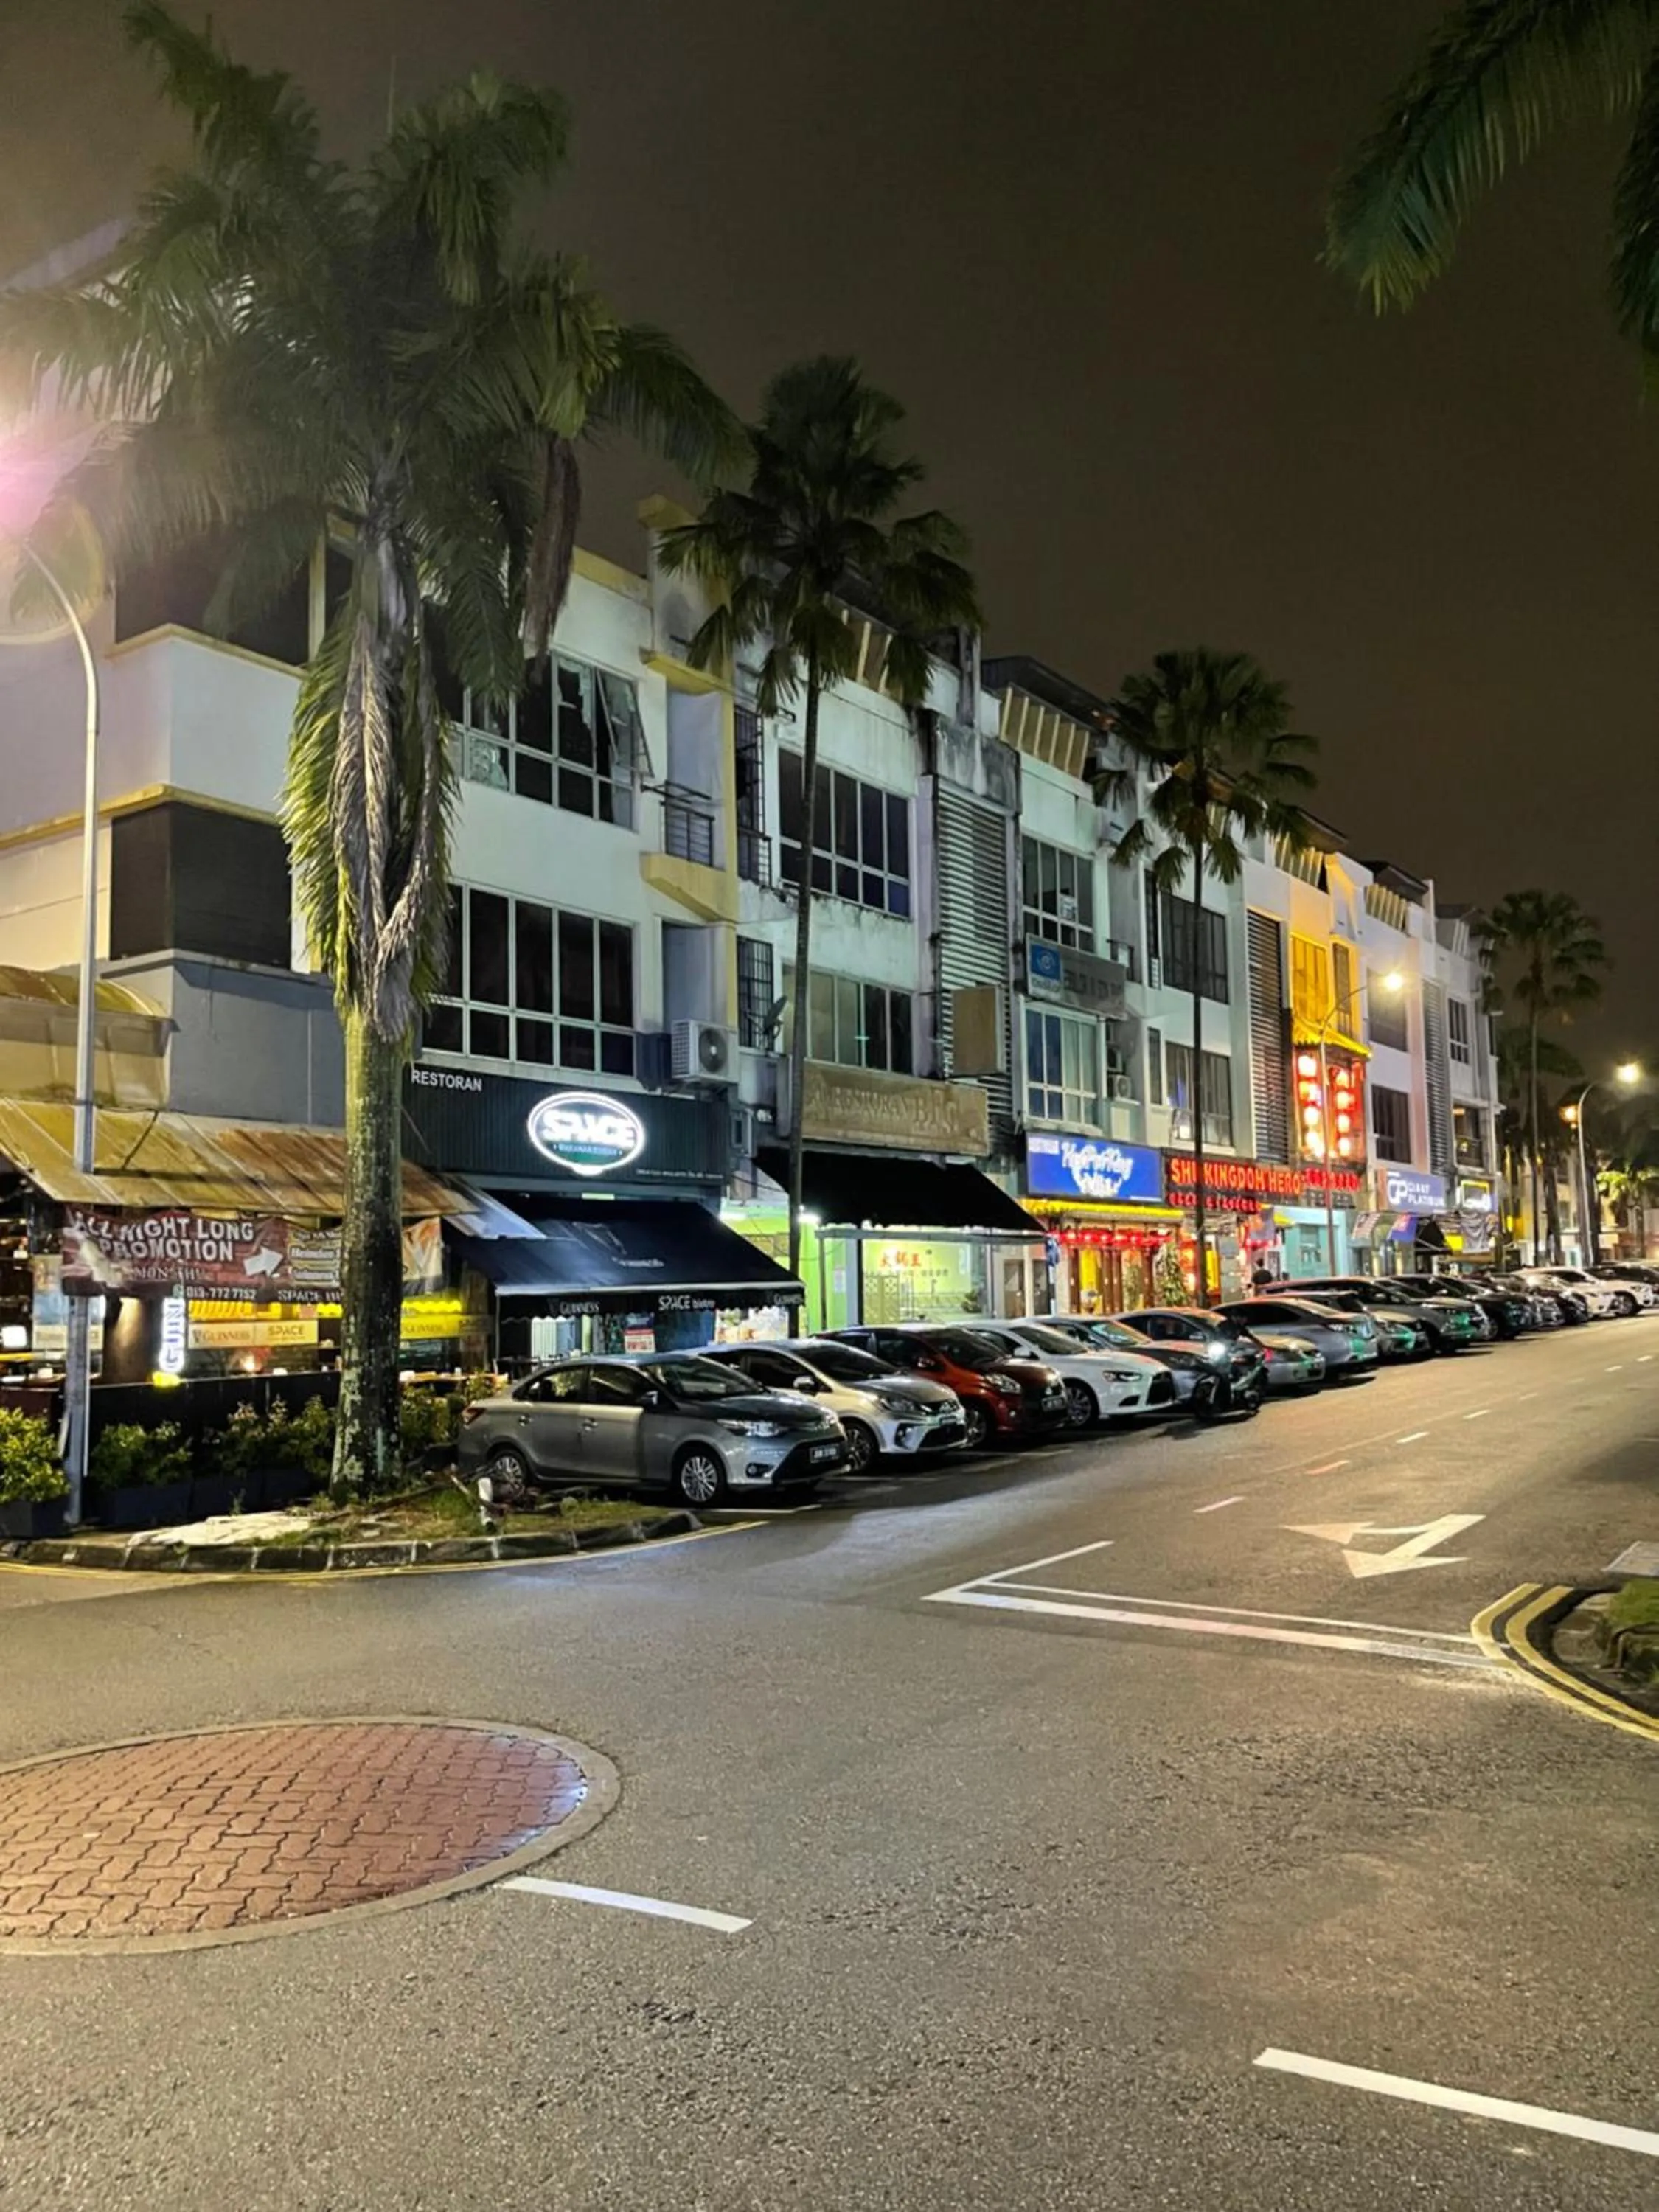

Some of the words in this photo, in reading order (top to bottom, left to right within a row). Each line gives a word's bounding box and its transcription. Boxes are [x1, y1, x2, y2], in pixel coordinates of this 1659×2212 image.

[411, 1069, 482, 1091] RESTORAN
[1203, 1161, 1265, 1190] KINGDOM
[1268, 1170, 1301, 1194] HERO
[120, 1217, 190, 1242] NIGHT
[197, 1221, 254, 1240] LONG
[99, 1237, 234, 1262] PROMOTION
[658, 1295, 691, 1311] SPACE
[267, 1324, 305, 1336] SPACE
